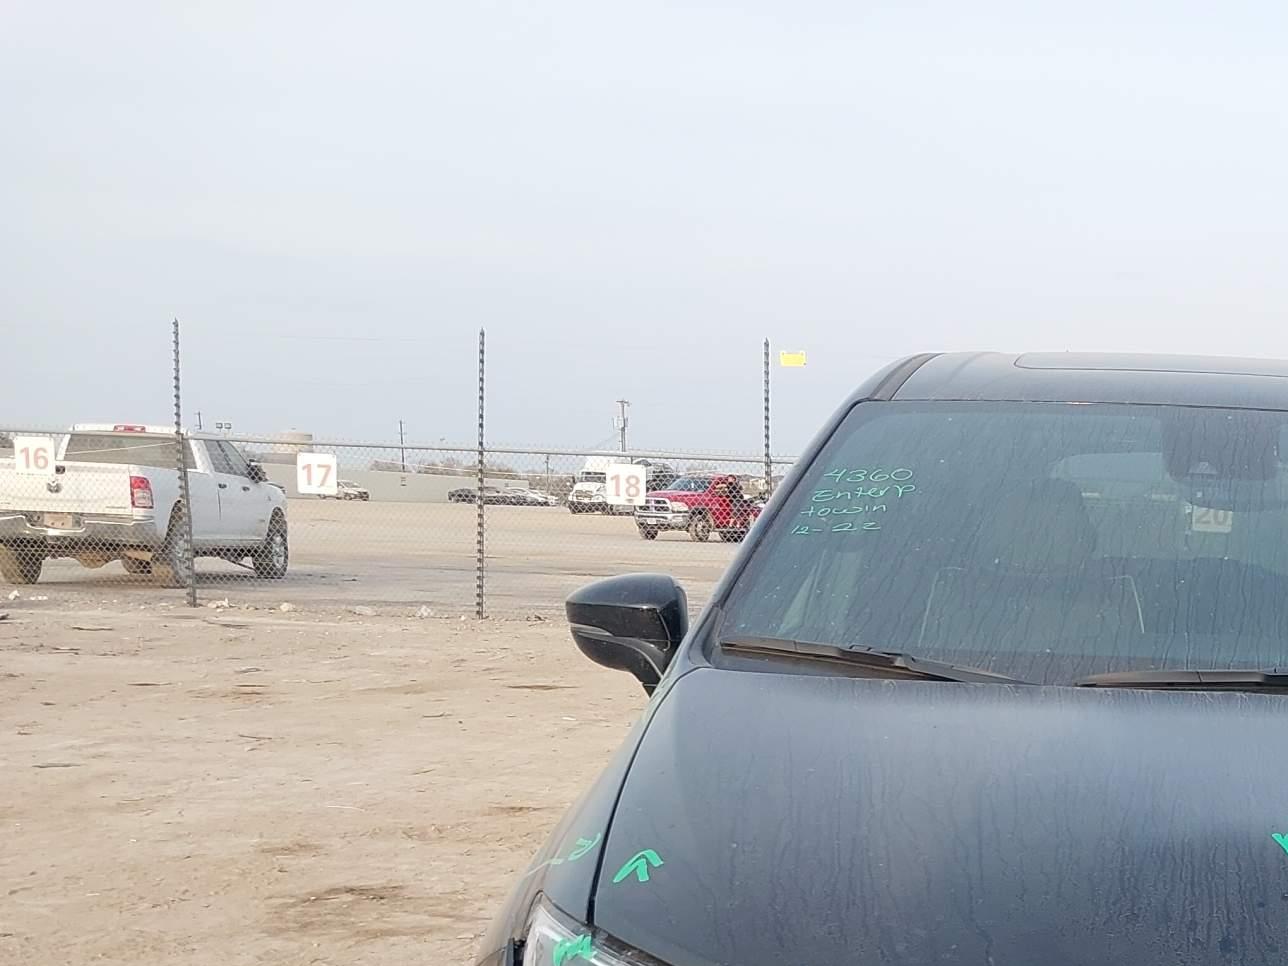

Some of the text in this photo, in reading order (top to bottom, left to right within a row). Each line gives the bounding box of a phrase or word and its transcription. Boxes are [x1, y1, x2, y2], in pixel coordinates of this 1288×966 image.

[20, 447, 49, 470] 16
[302, 463, 332, 488] 17
[610, 474, 641, 498] 18
[823, 467, 913, 483] 4360
